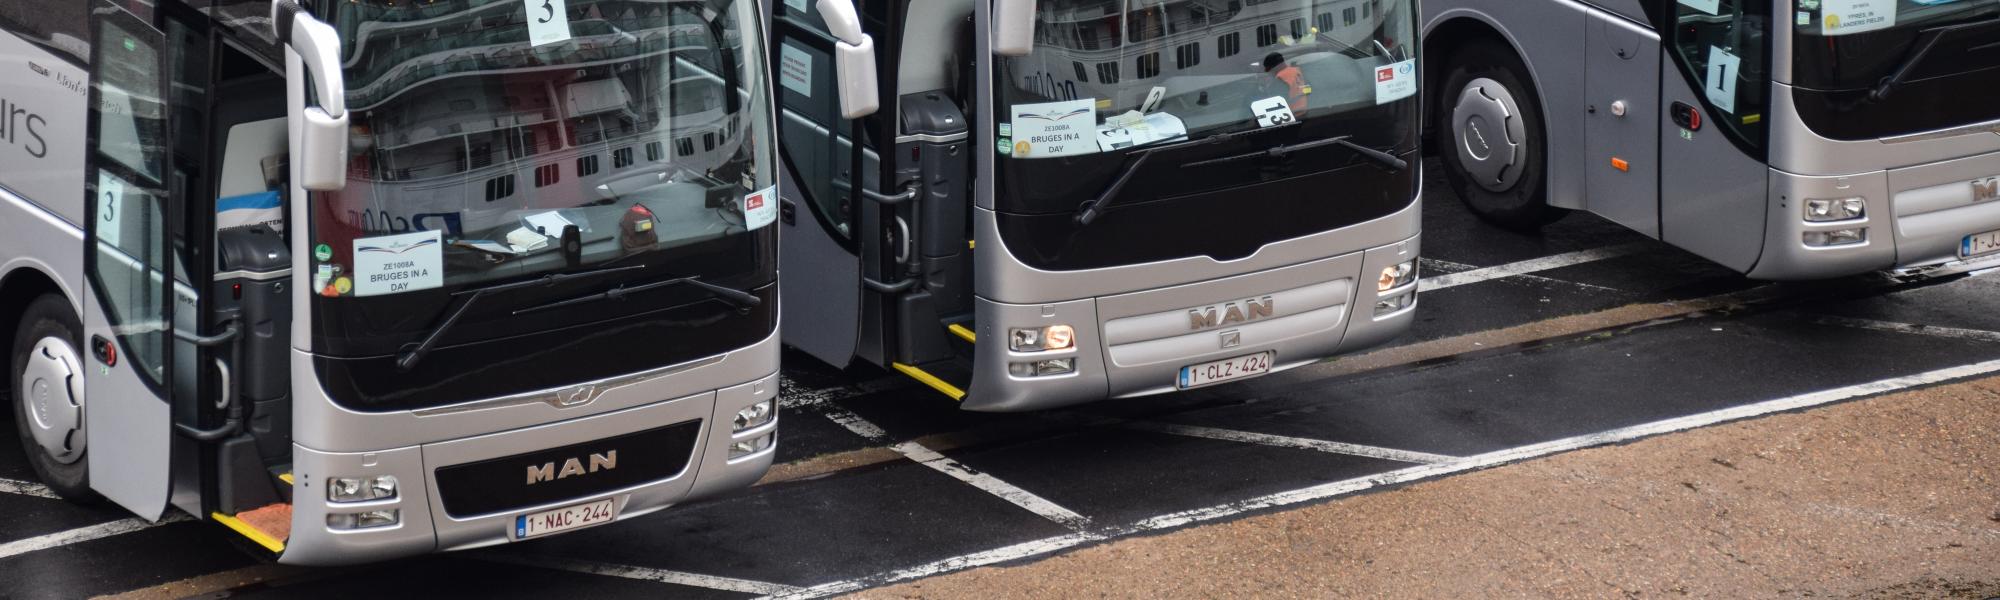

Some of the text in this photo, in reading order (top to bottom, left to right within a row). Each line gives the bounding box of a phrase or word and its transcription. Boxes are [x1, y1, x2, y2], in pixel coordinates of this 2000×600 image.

[537, 0, 554, 23] 3
[1715, 64, 1727, 92] 1
[1147, 91, 1160, 113] 2
[1265, 102, 1292, 125] 13
[1031, 132, 1080, 143] BRUGES IN A
[1048, 145, 1064, 153] DAY
[103, 191, 114, 222] 3
[370, 268, 428, 283] BRUGES IN A
[391, 282, 409, 291] DAY
[1188, 296, 1274, 330] MAN
[1191, 355, 1267, 383] 1-CLZ-424
[526, 449, 617, 485] MAN
[528, 502, 609, 533] 1-NAC-244
